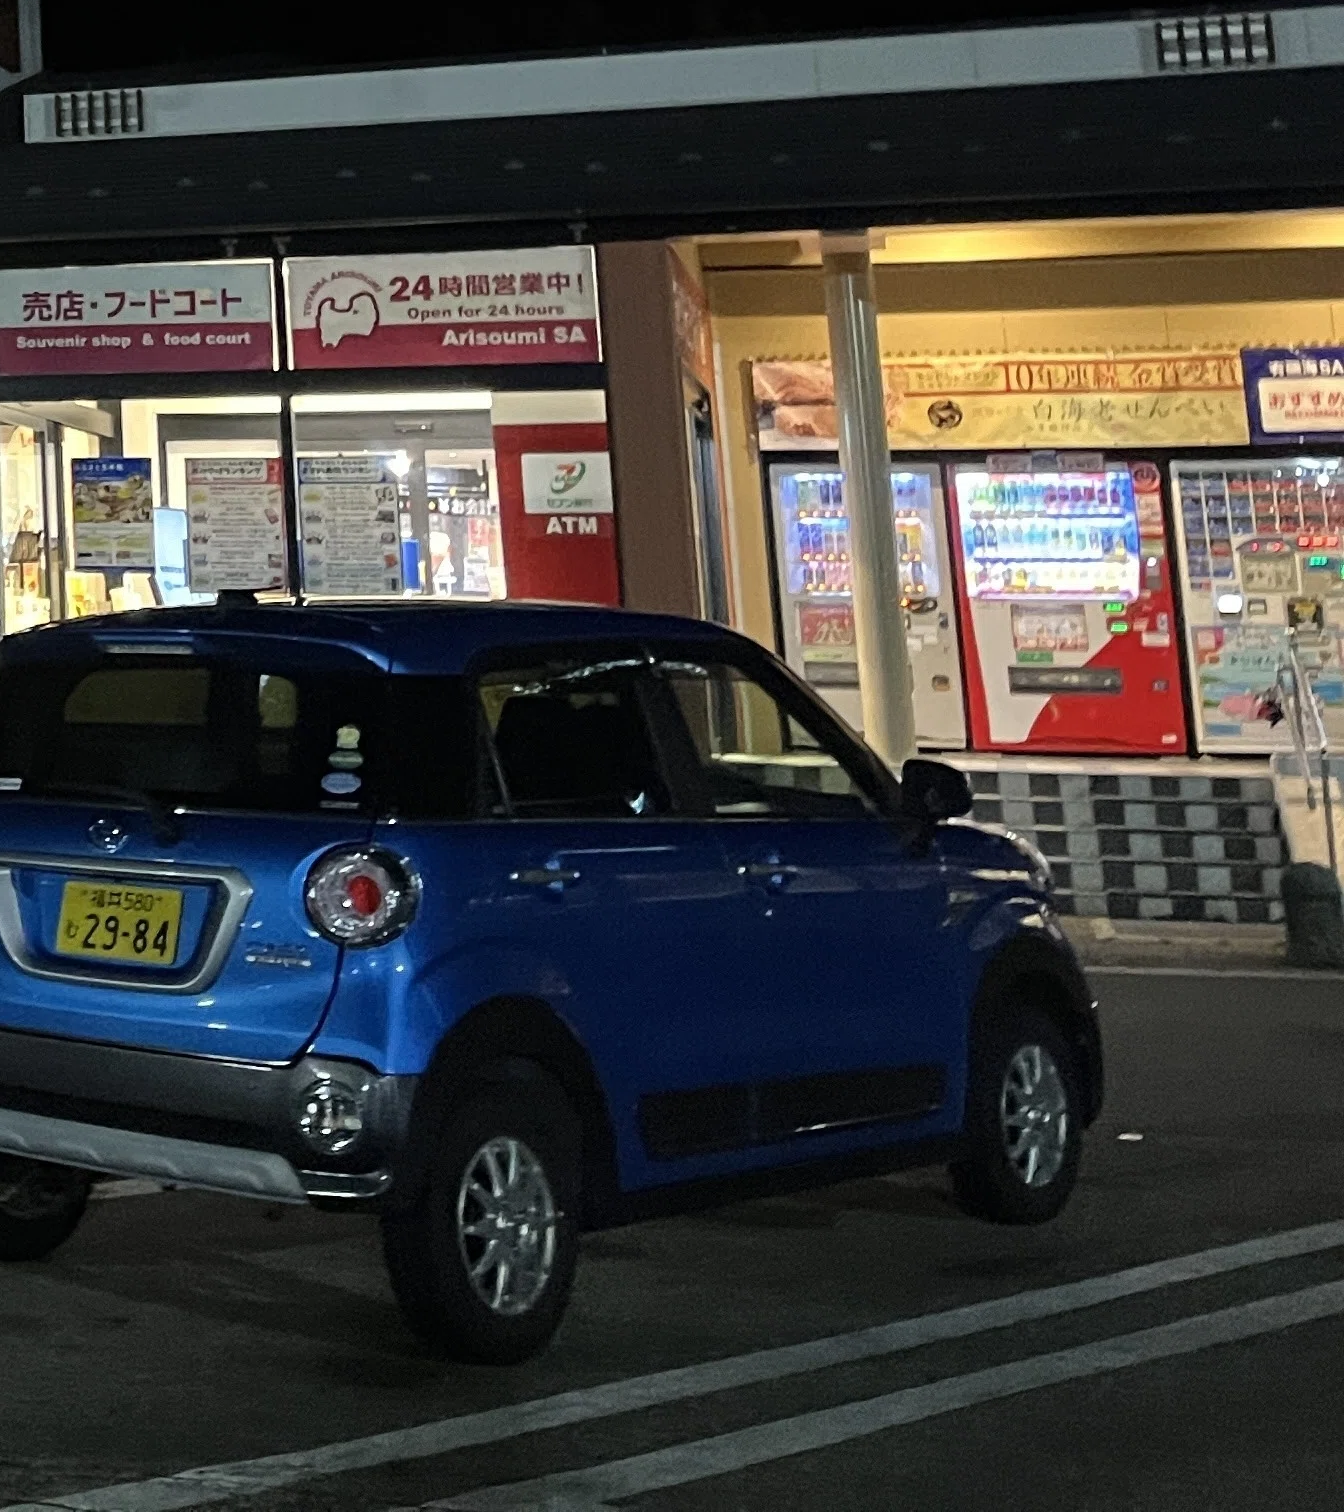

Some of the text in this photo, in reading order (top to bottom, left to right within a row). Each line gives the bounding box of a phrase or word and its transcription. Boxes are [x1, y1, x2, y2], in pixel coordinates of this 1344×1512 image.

[22, 288, 242, 322] 売店・フードコート
[407, 302, 565, 322] Open for 24 hours
[16, 331, 251, 349] Souvenir shop & food court
[441, 325, 587, 347] Arisoumi SA
[545, 516, 598, 535] ATM
[82, 914, 169, 957] 29-84
